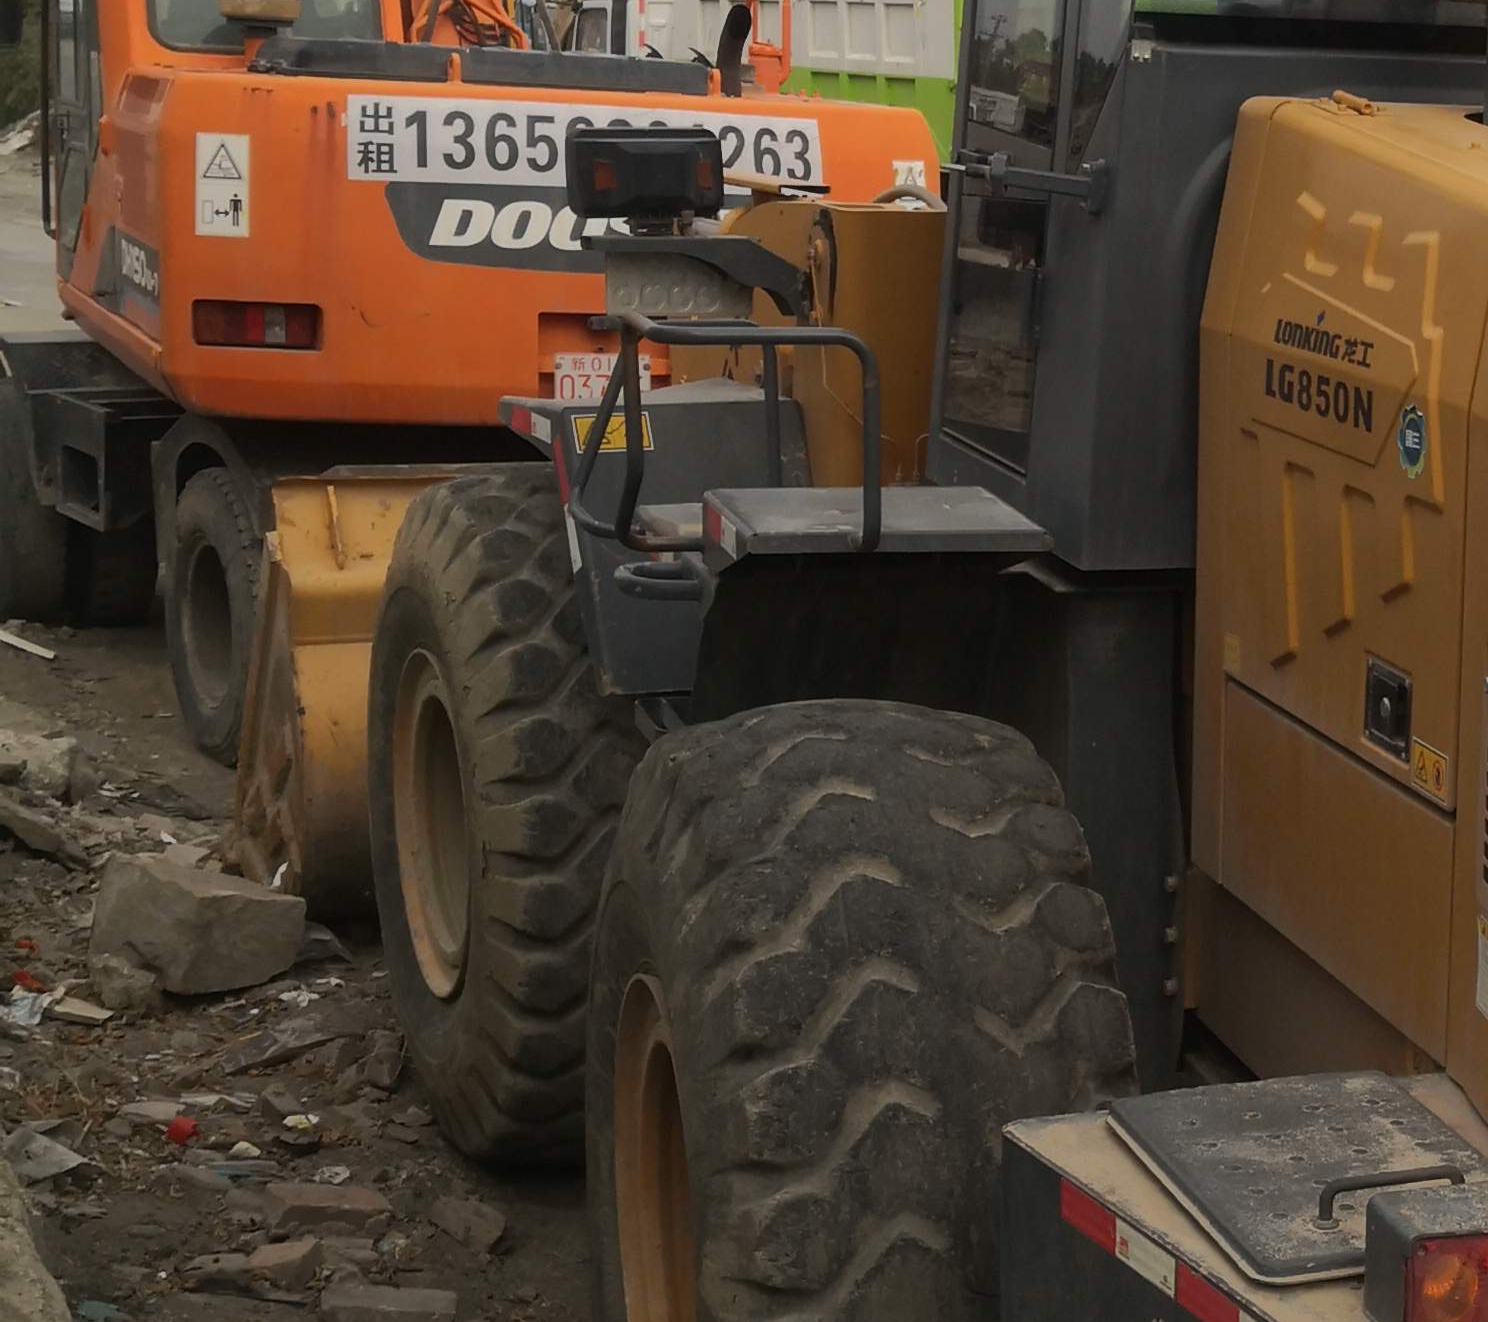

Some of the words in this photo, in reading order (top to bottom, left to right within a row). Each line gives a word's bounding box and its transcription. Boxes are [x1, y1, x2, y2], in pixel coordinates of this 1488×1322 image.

[357, 101, 397, 174] 出租
[404, 110, 812, 181] 1365263
[572, 357, 611, 372] 新01
[1341, 337, 1375, 368] 龙工
[1264, 357, 1373, 433] LG850N
